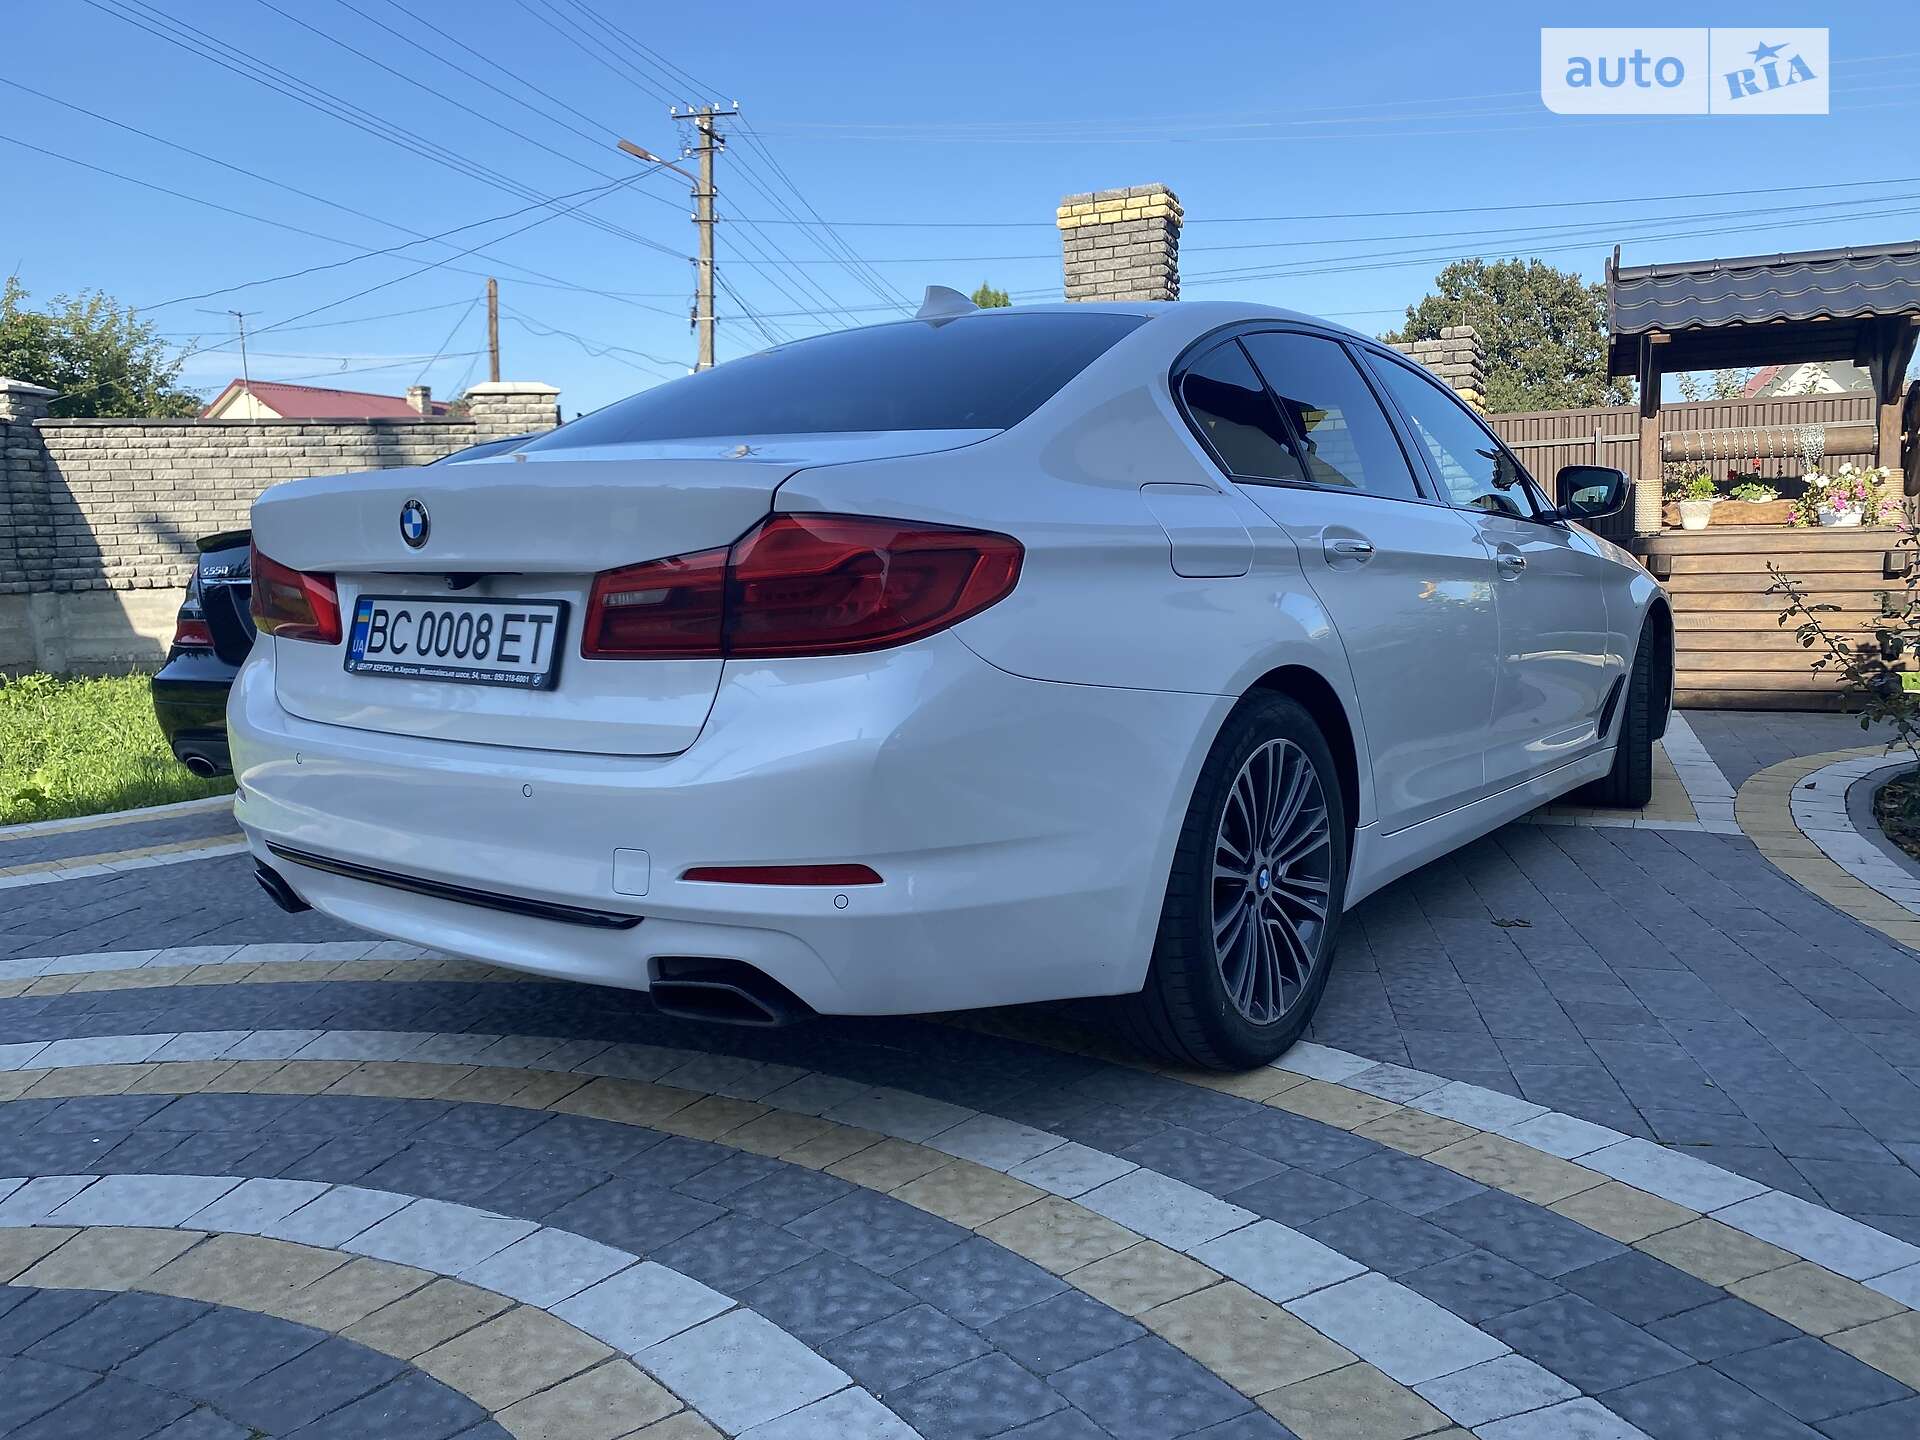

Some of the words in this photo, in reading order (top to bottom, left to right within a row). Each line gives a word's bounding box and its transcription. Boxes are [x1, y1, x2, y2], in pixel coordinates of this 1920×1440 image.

[352, 639, 364, 653] UA
[367, 609, 412, 654] BC
[416, 610, 493, 660] 0008
[497, 613, 553, 664] ET
